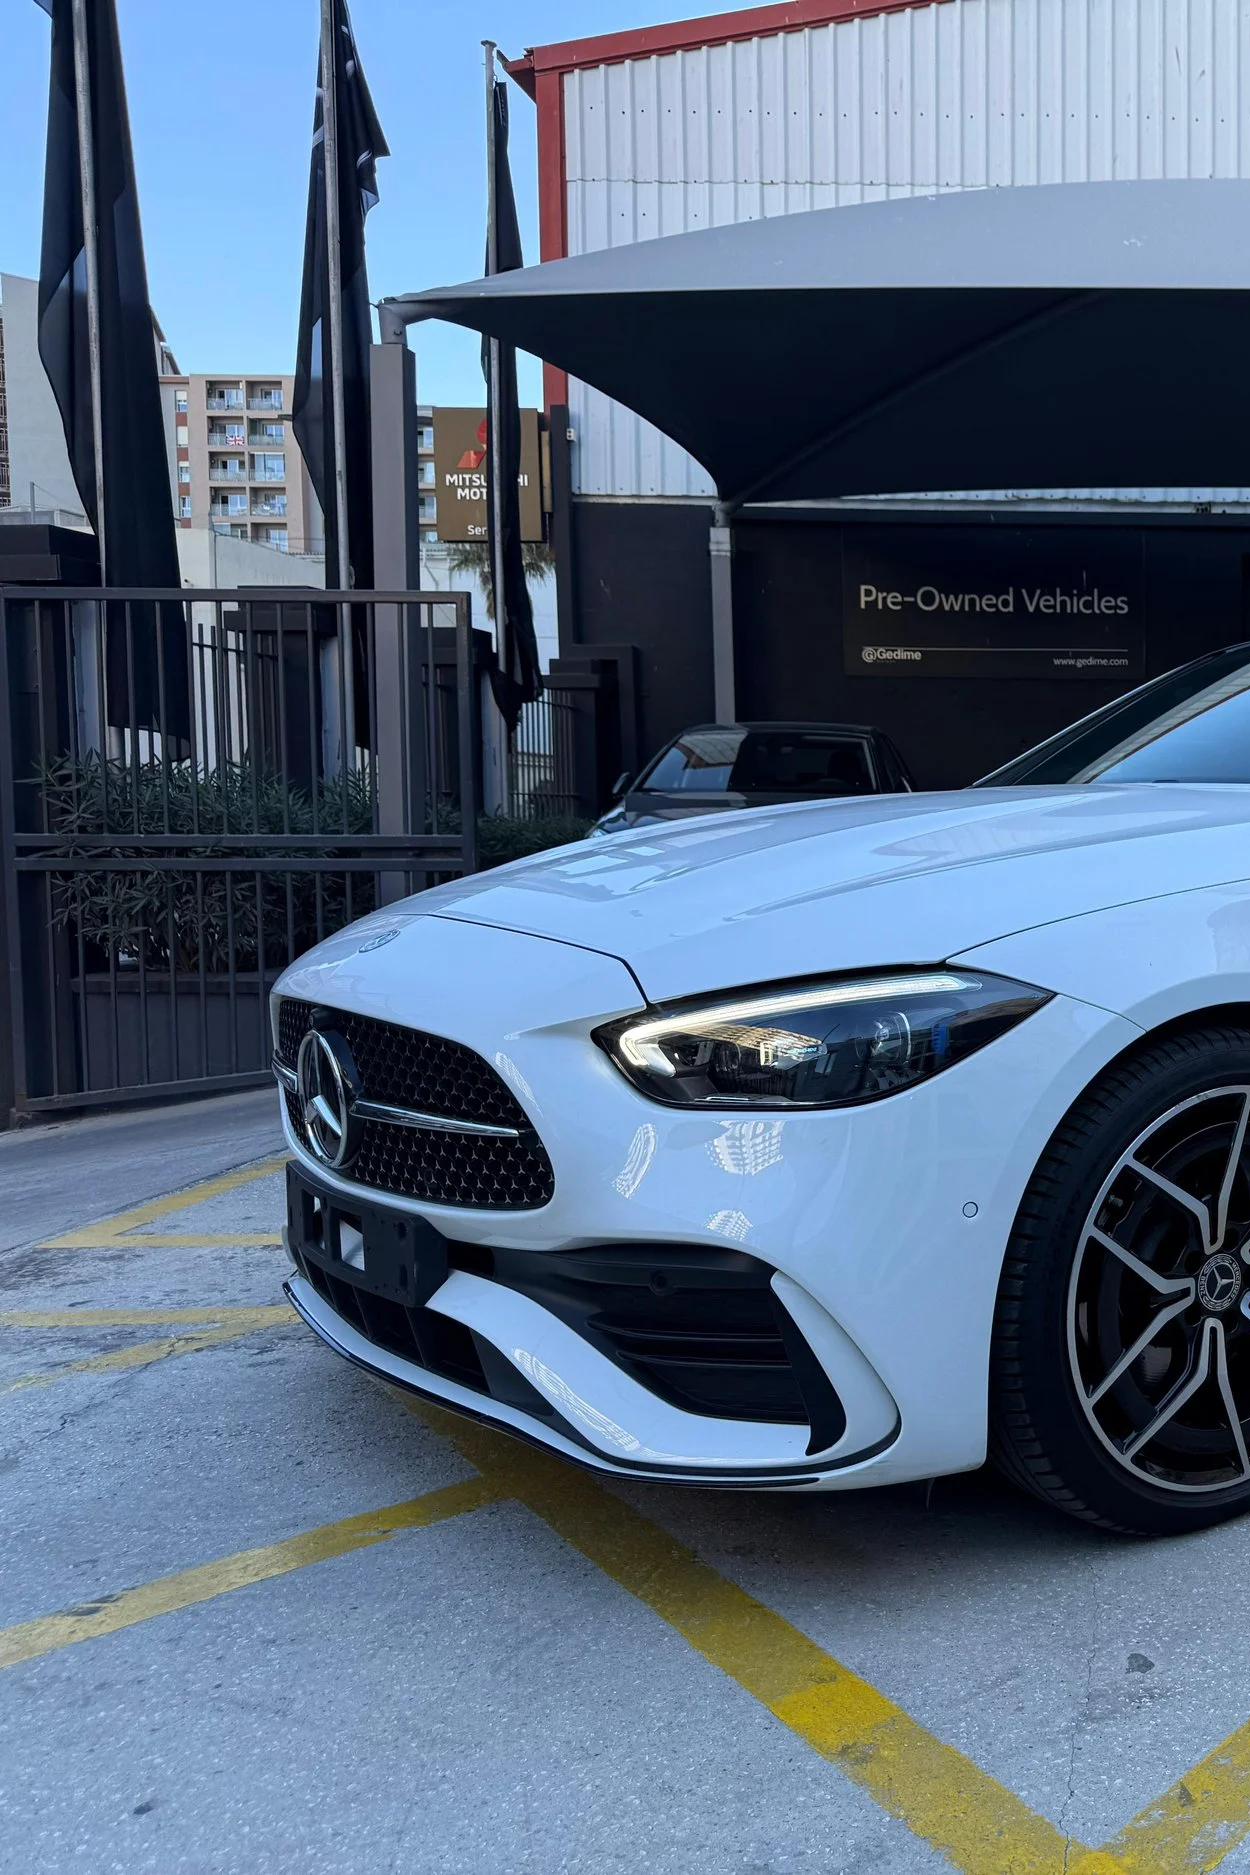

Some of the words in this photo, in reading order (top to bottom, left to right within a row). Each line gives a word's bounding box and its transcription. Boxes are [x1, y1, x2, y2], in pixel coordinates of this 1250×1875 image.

[445, 473, 529, 487] MITSUHI
[457, 488, 488, 500] MOT
[467, 524, 488, 535] Ser
[859, 584, 1014, 613] Pre-Owned
[1021, 587, 1129, 614] Vehicles
[1053, 655, 1129, 668] www.gedime.com
